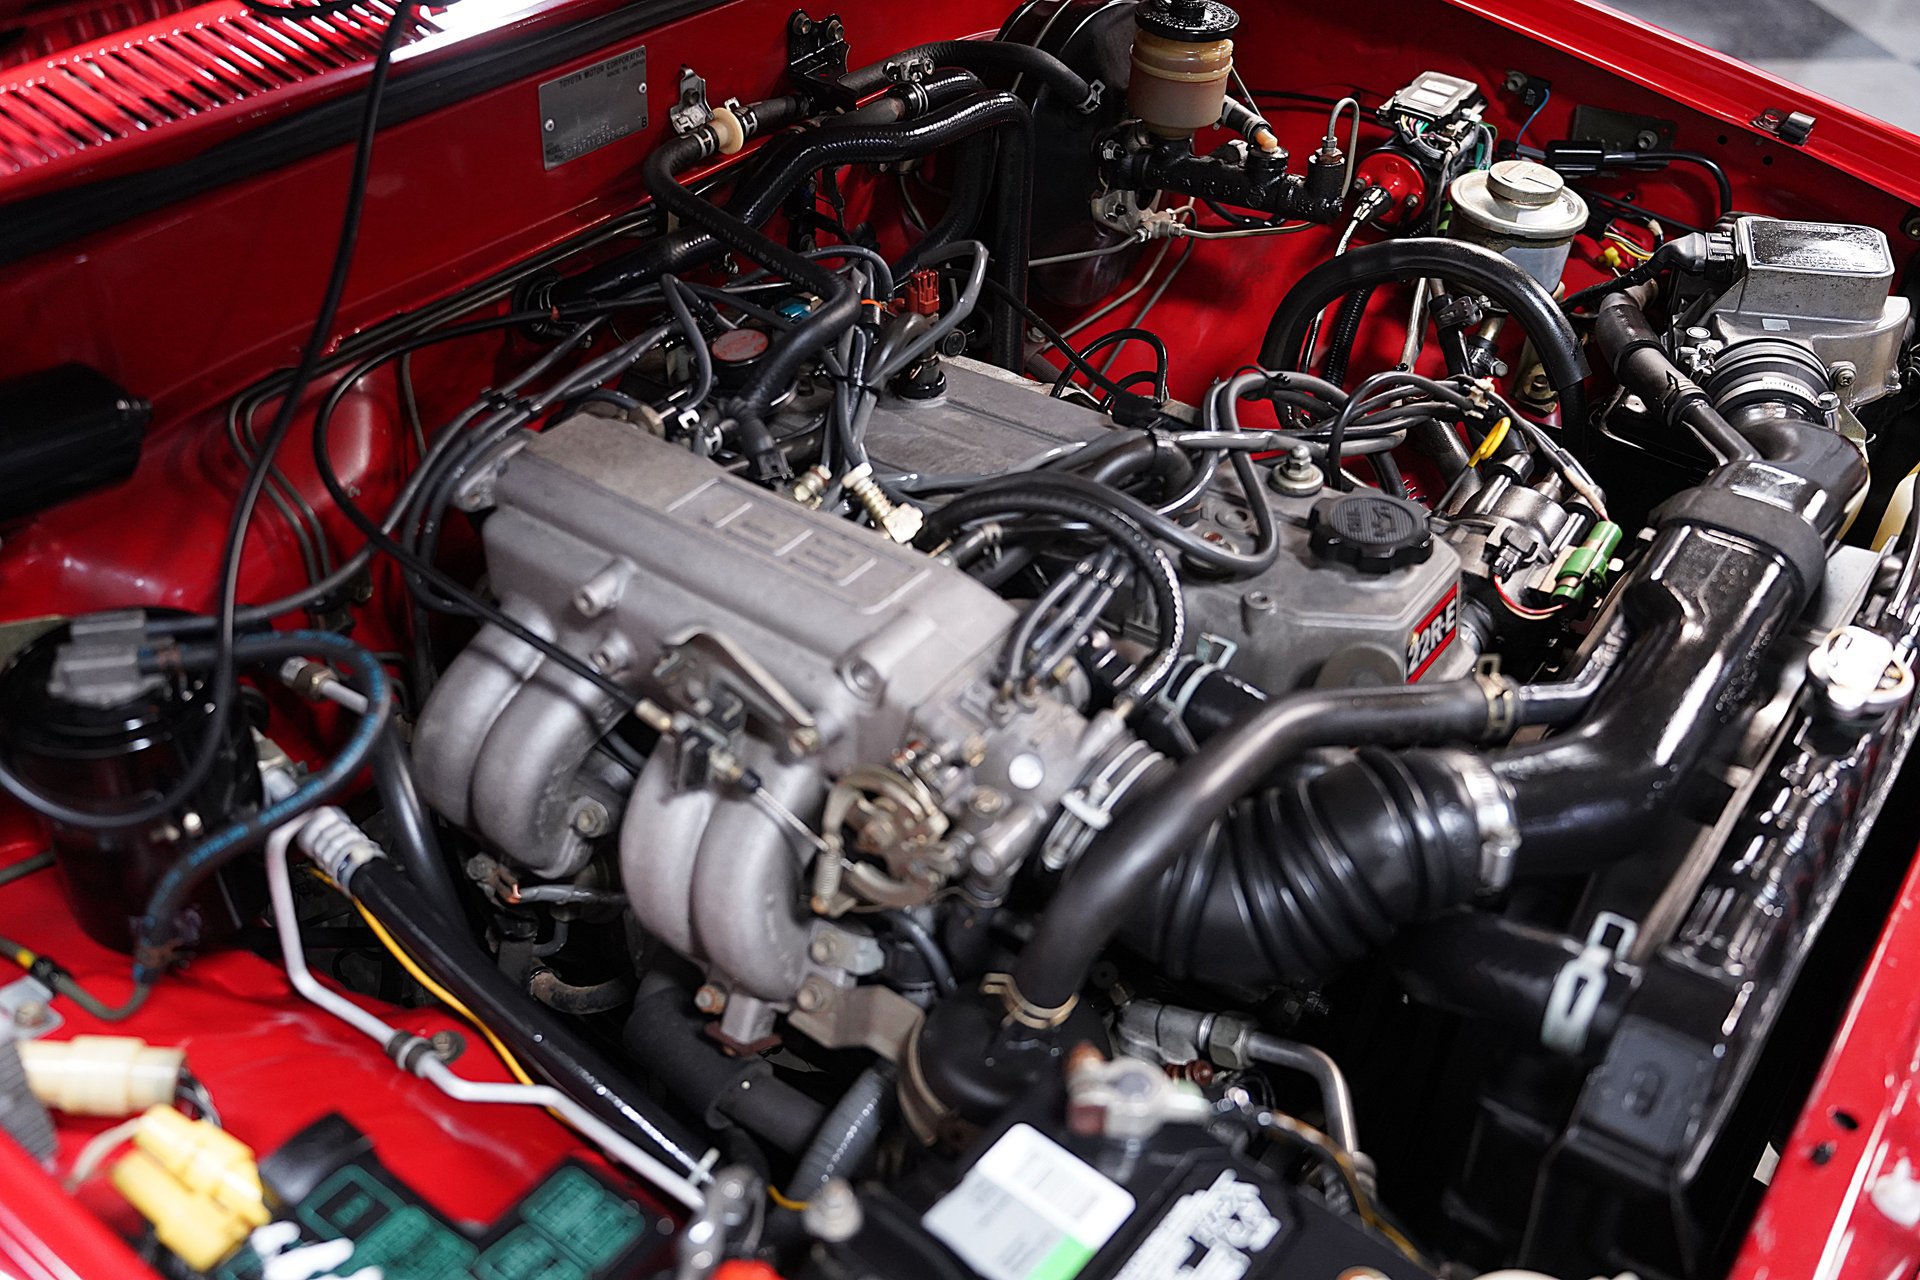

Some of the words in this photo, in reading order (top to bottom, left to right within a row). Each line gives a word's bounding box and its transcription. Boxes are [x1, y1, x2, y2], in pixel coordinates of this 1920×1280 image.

[559, 75, 582, 88] TOYOTA
[584, 64, 605, 79] MOTOR
[606, 50, 645, 69] CORPORATION
[1407, 597, 1457, 676] 22R-E
